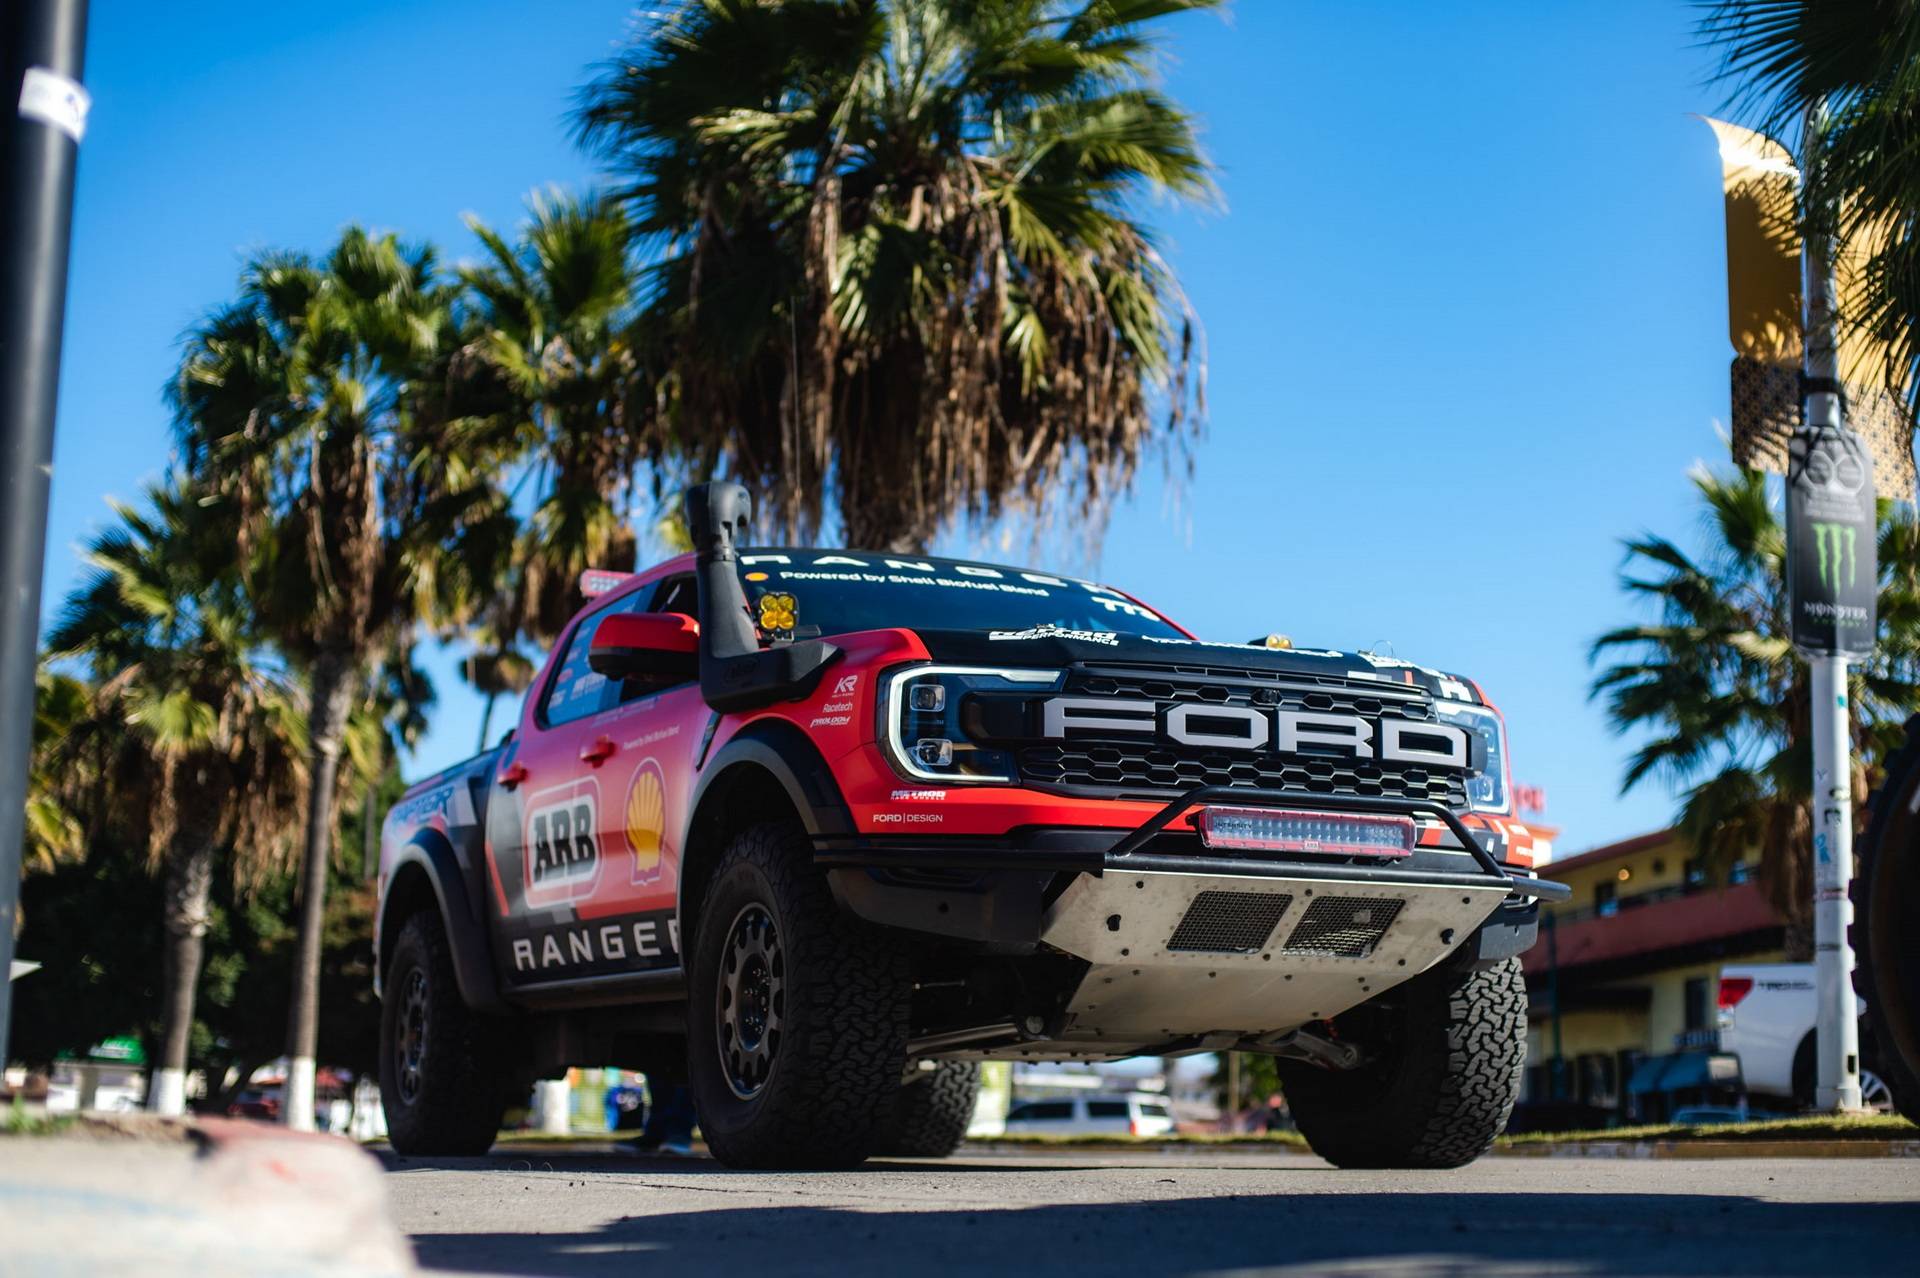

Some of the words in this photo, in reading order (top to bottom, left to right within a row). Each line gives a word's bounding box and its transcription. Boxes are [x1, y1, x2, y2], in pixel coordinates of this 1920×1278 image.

[780, 571, 862, 582] Powered
[863, 573, 885, 583] by
[888, 575, 935, 586] Shell
[1000, 584, 1050, 597] Blend
[1021, 632, 1119, 646] PERFORMANCE
[833, 675, 858, 693] KR
[1043, 699, 1467, 768] FORD
[873, 814, 902, 823] FORD
[906, 814, 943, 822] DESIGN
[533, 803, 596, 884] ARB
